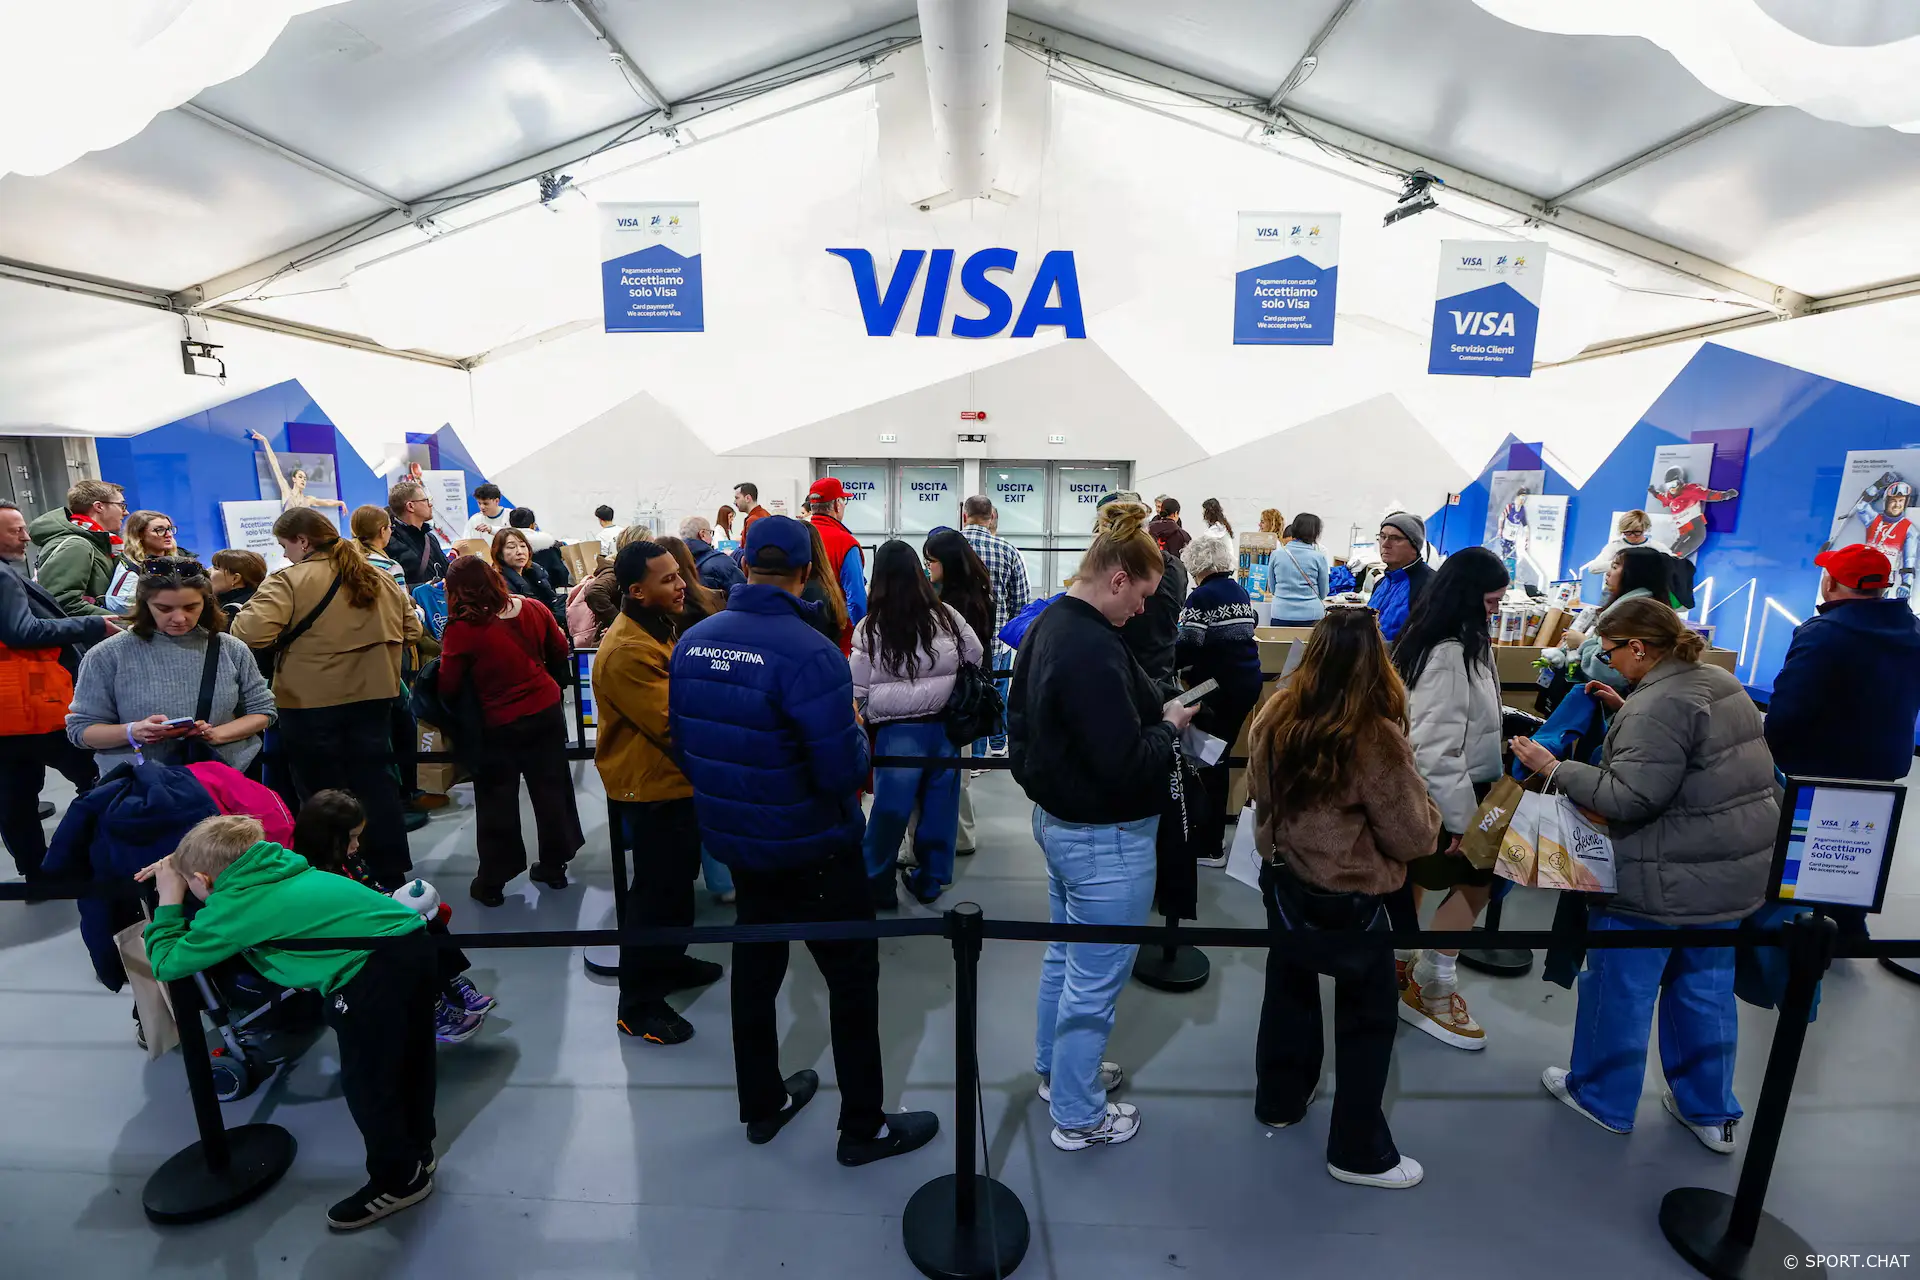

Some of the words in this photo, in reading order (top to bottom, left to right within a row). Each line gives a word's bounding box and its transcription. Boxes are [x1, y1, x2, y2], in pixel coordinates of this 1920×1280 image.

[617, 218, 639, 227] VISA
[1257, 228, 1279, 237] VISA
[1462, 257, 1482, 266] VISA
[621, 267, 651, 275] Pagamenti
[620, 275, 684, 286] Accettiamo
[629, 287, 652, 298] solo
[654, 287, 677, 297] Visa
[825, 247, 1087, 339] VISA
[1254, 286, 1318, 297] Accettiamo
[646, 303, 674, 311] payment?
[1261, 298, 1285, 309] solo
[1287, 298, 1310, 309] Visa
[637, 310, 655, 318] accept
[655, 310, 668, 318] only
[1277, 315, 1306, 323] payment?
[1448, 310, 1515, 337] VISA
[1287, 322, 1299, 330] only
[1450, 344, 1486, 354] Servizio
[1486, 345, 1514, 355] Clienti
[911, 482, 948, 491] USCITA
[996, 483, 1034, 492] USCITA
[1070, 484, 1108, 493] USCITA
[919, 493, 940, 502] EXIT
[1004, 494, 1025, 503] EXIT
[1078, 495, 1099, 503] EXIT
[686, 646, 721, 659] MILANO
[722, 649, 765, 665] CORTINA
[710, 659, 730, 671] 2026
[421, 731, 435, 752] VIS
[1170, 771, 1180, 800] 2026
[1478, 806, 1507, 832] VISA
[1821, 819, 1839, 827] VISA
[1812, 842, 1872, 854] Accettiamo
[1811, 851, 1832, 860] solo
[1834, 852, 1856, 862] Visa
